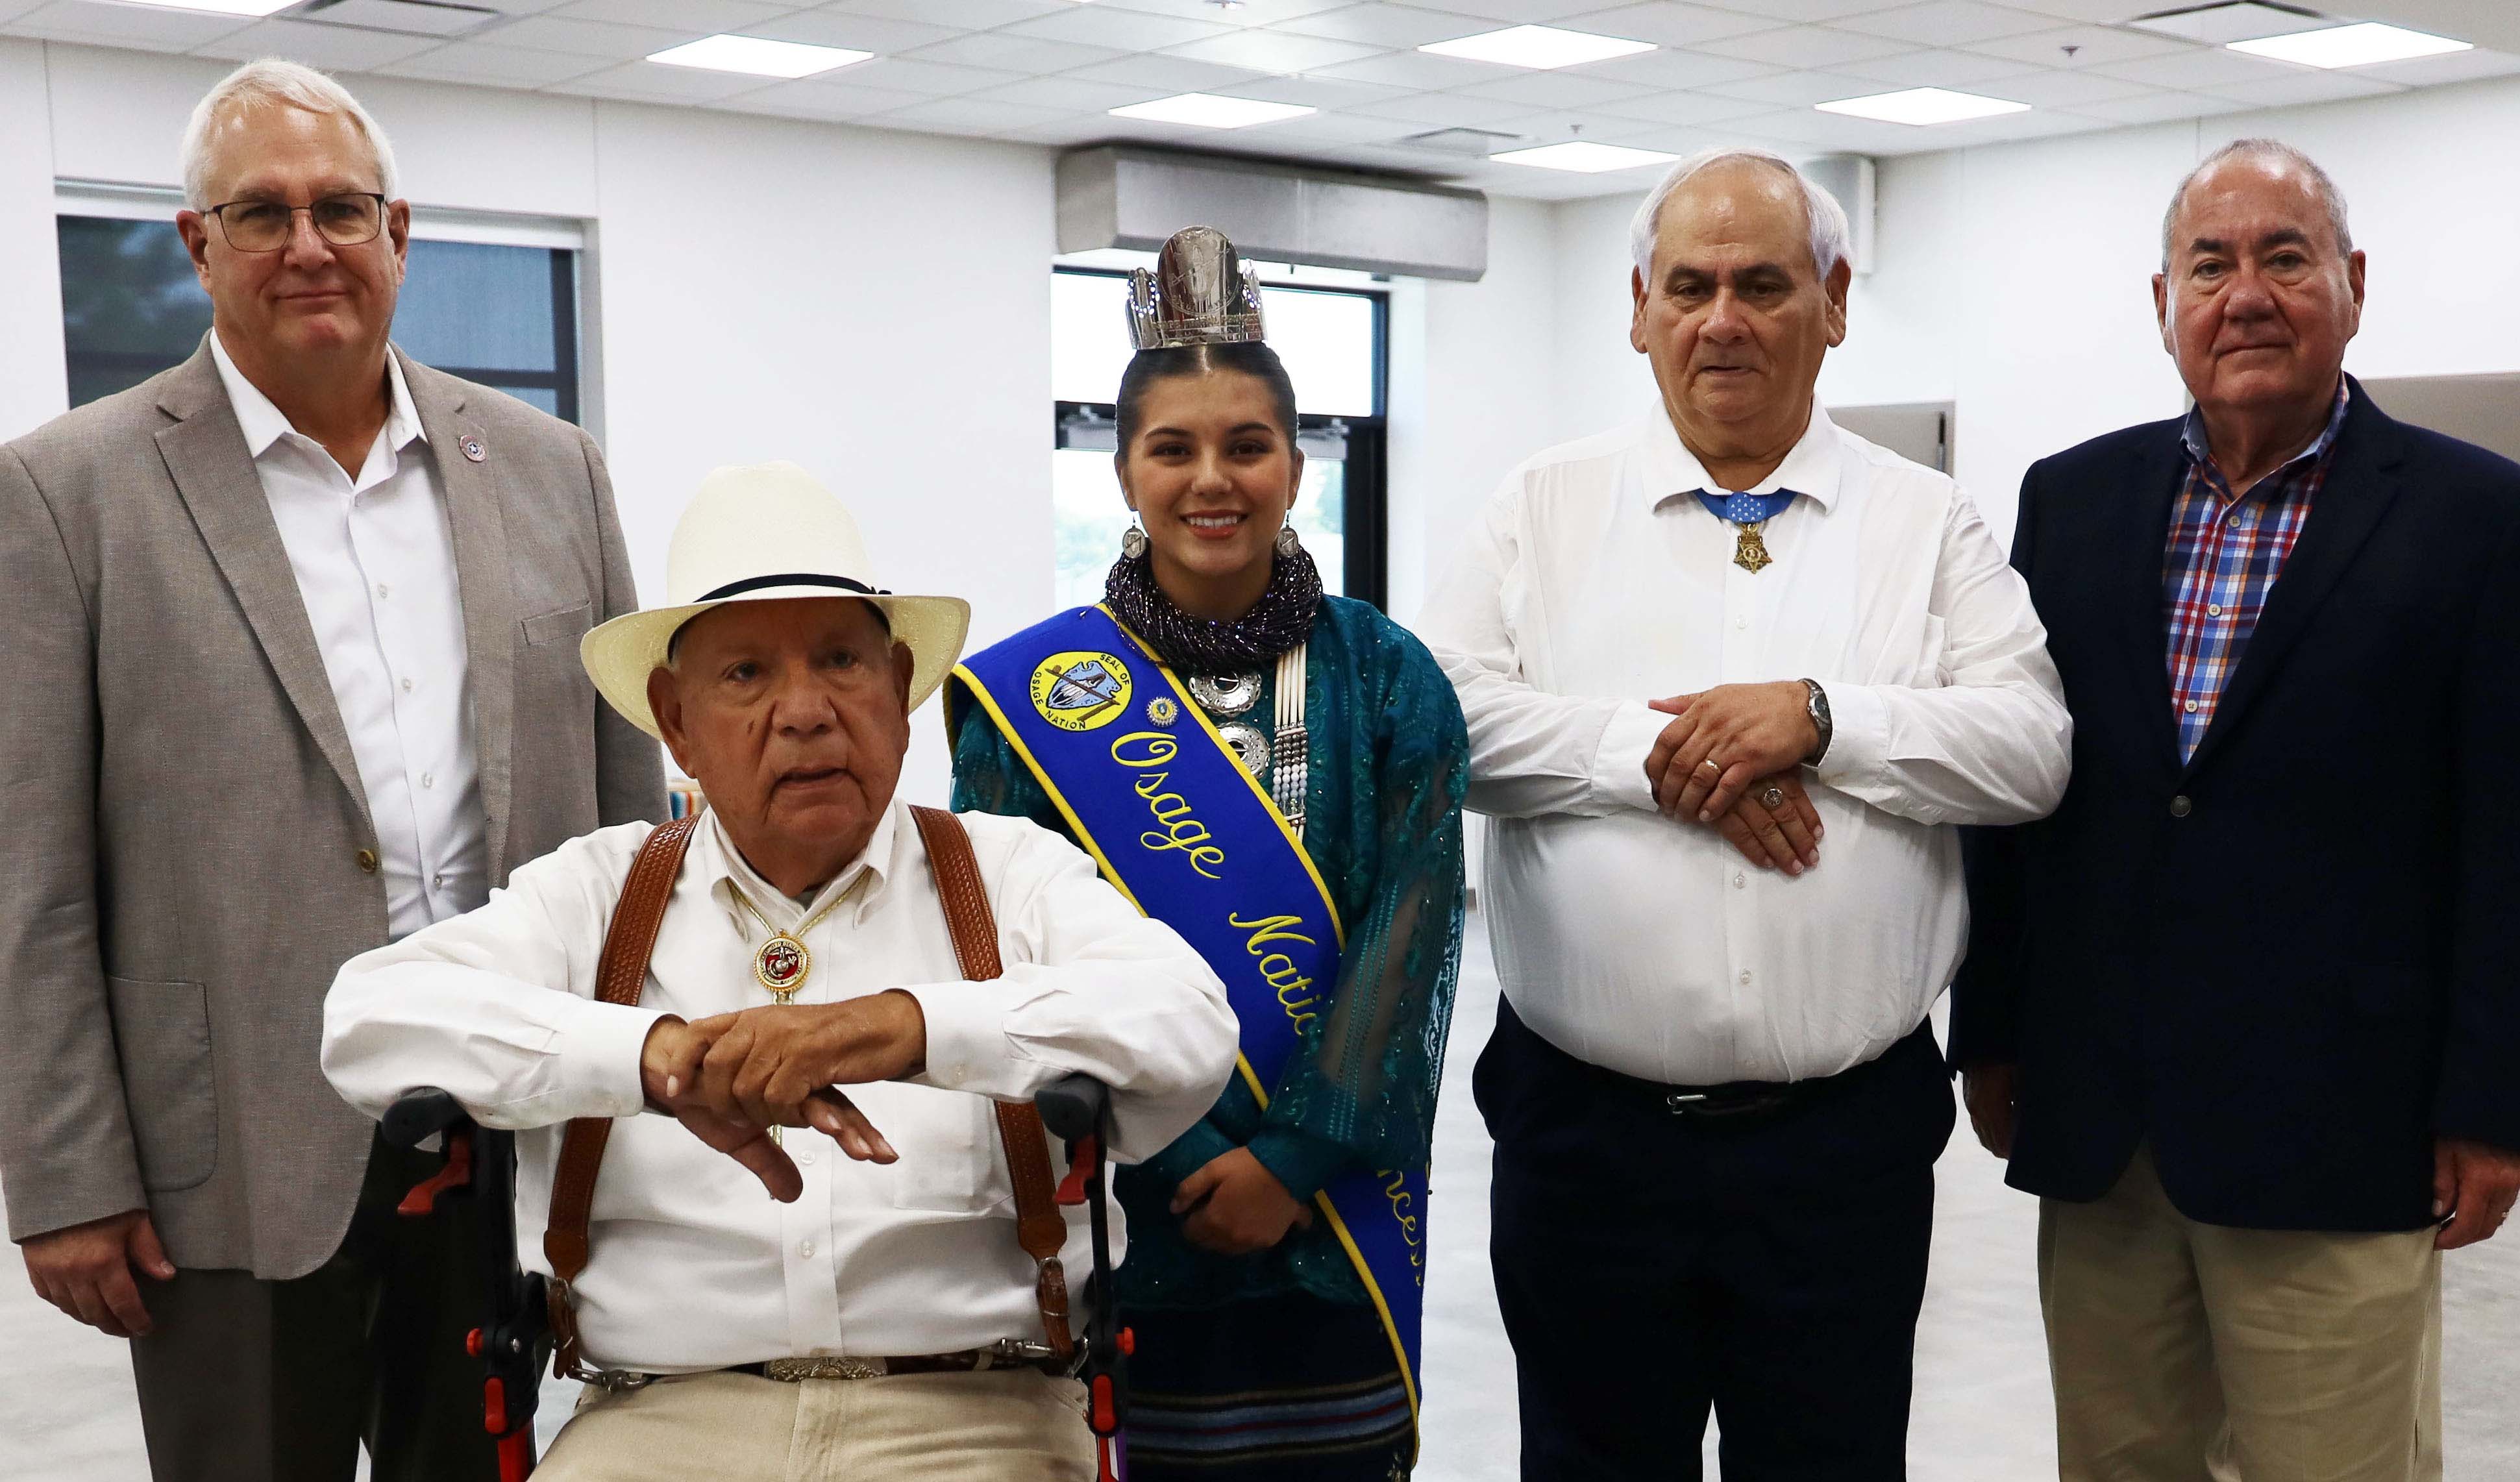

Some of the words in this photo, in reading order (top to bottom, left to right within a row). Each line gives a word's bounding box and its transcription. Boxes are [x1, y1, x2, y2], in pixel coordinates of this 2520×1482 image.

[1100, 654, 1120, 671] SEAL
[1120, 673, 1130, 685] OF
[1032, 672, 1044, 705] OSAGE
[1045, 710, 1086, 730] NATION
[1111, 732, 1225, 879] Osage
